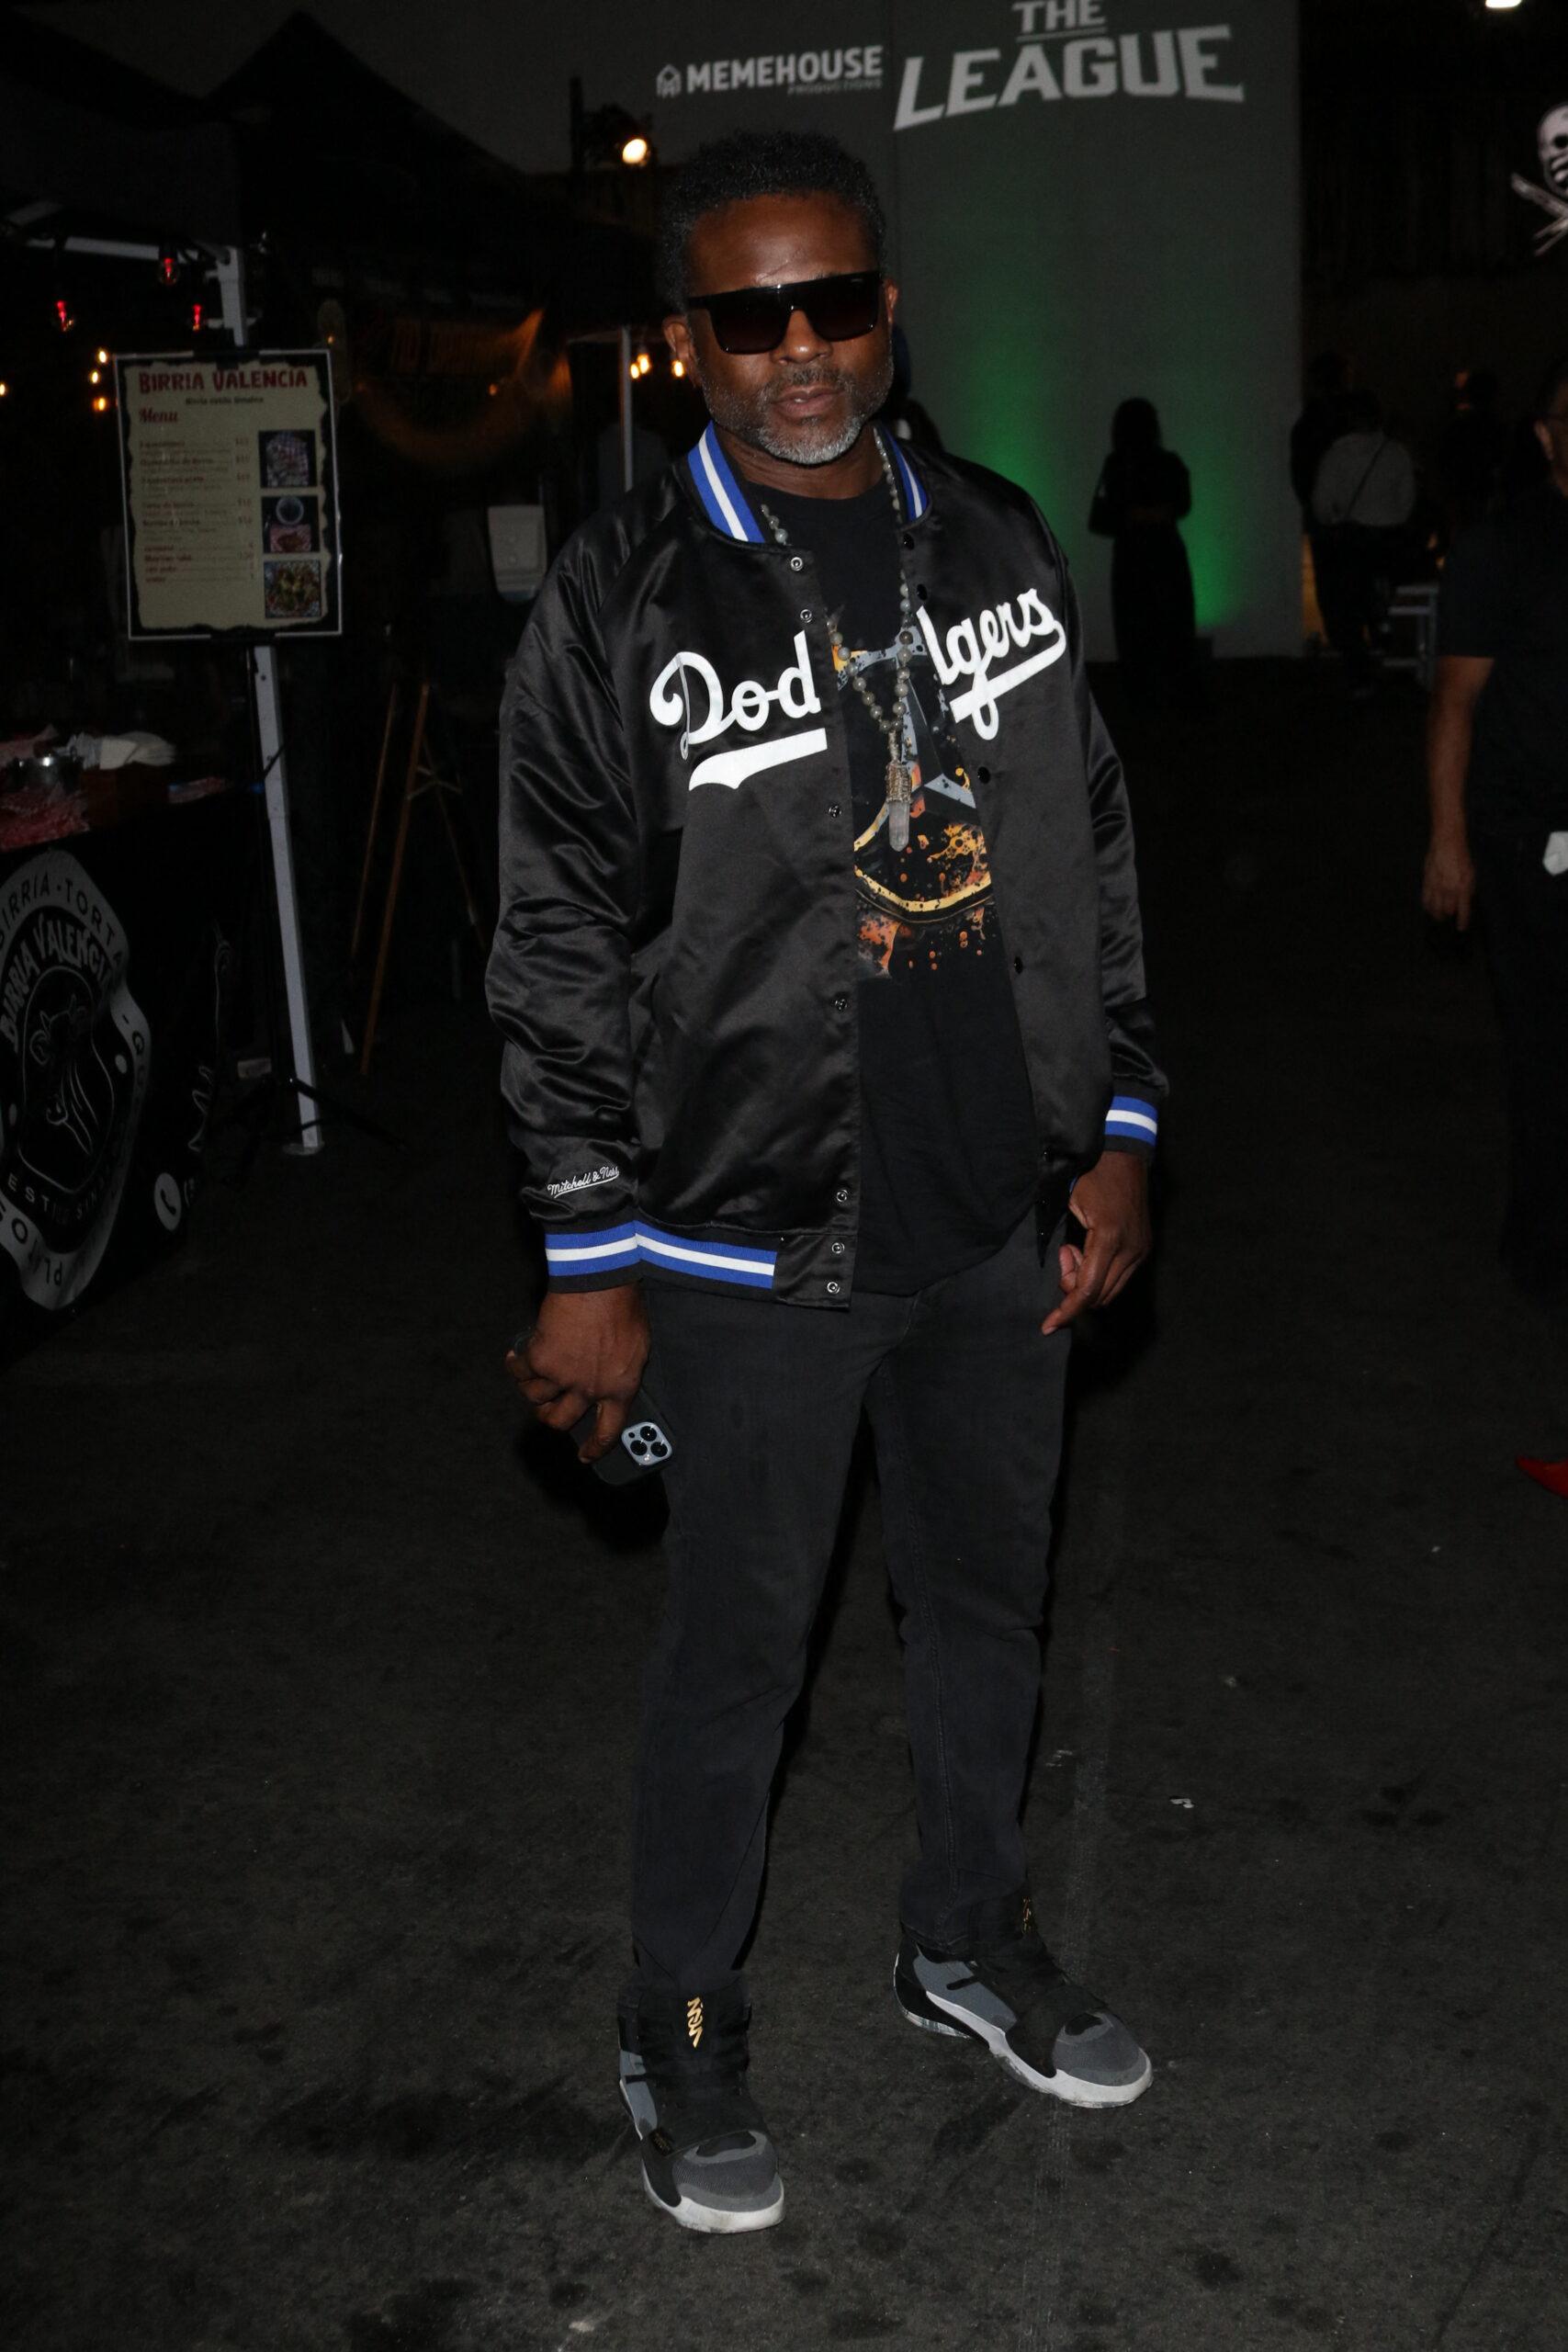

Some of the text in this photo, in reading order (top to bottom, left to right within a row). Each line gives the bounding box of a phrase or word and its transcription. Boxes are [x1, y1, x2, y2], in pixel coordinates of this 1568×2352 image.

[1012, 0, 1107, 33] THE
[687, 45, 884, 95] MEMEHOUSE
[893, 24, 1246, 131] LEAGUE
[139, 369, 307, 394] BIRRIA VALENCIA
[139, 408, 178, 424] Menu
[547, 1172, 591, 1195] Mitchell
